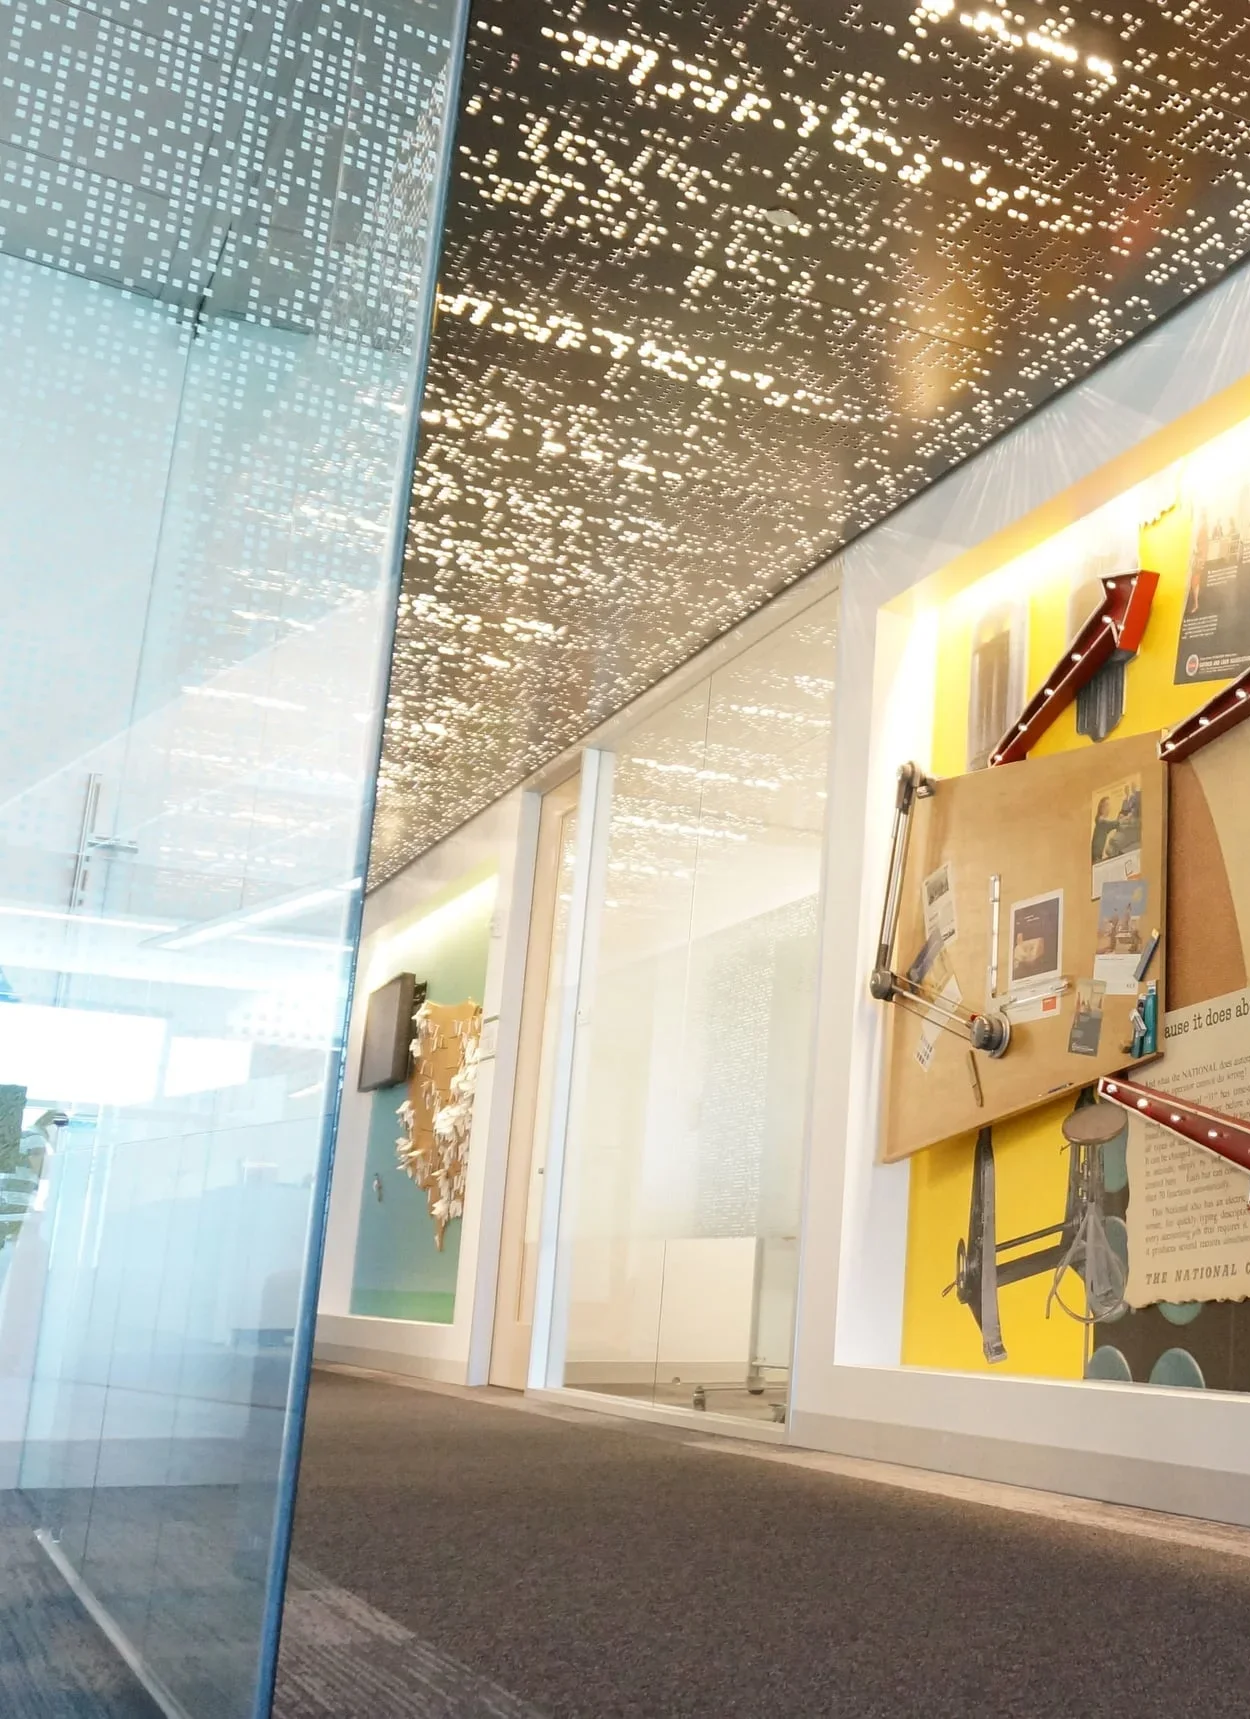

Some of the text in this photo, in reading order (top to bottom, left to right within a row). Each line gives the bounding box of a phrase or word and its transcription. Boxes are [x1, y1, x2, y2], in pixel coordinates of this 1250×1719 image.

[1164, 1024, 1190, 1040] ause
[1192, 1016, 1202, 1031] it
[1206, 1009, 1232, 1027] does
[1182, 1062, 1217, 1078] NATIONAL
[1146, 1271, 1168, 1285] THE
[1174, 1262, 1238, 1283] NATIONAL
